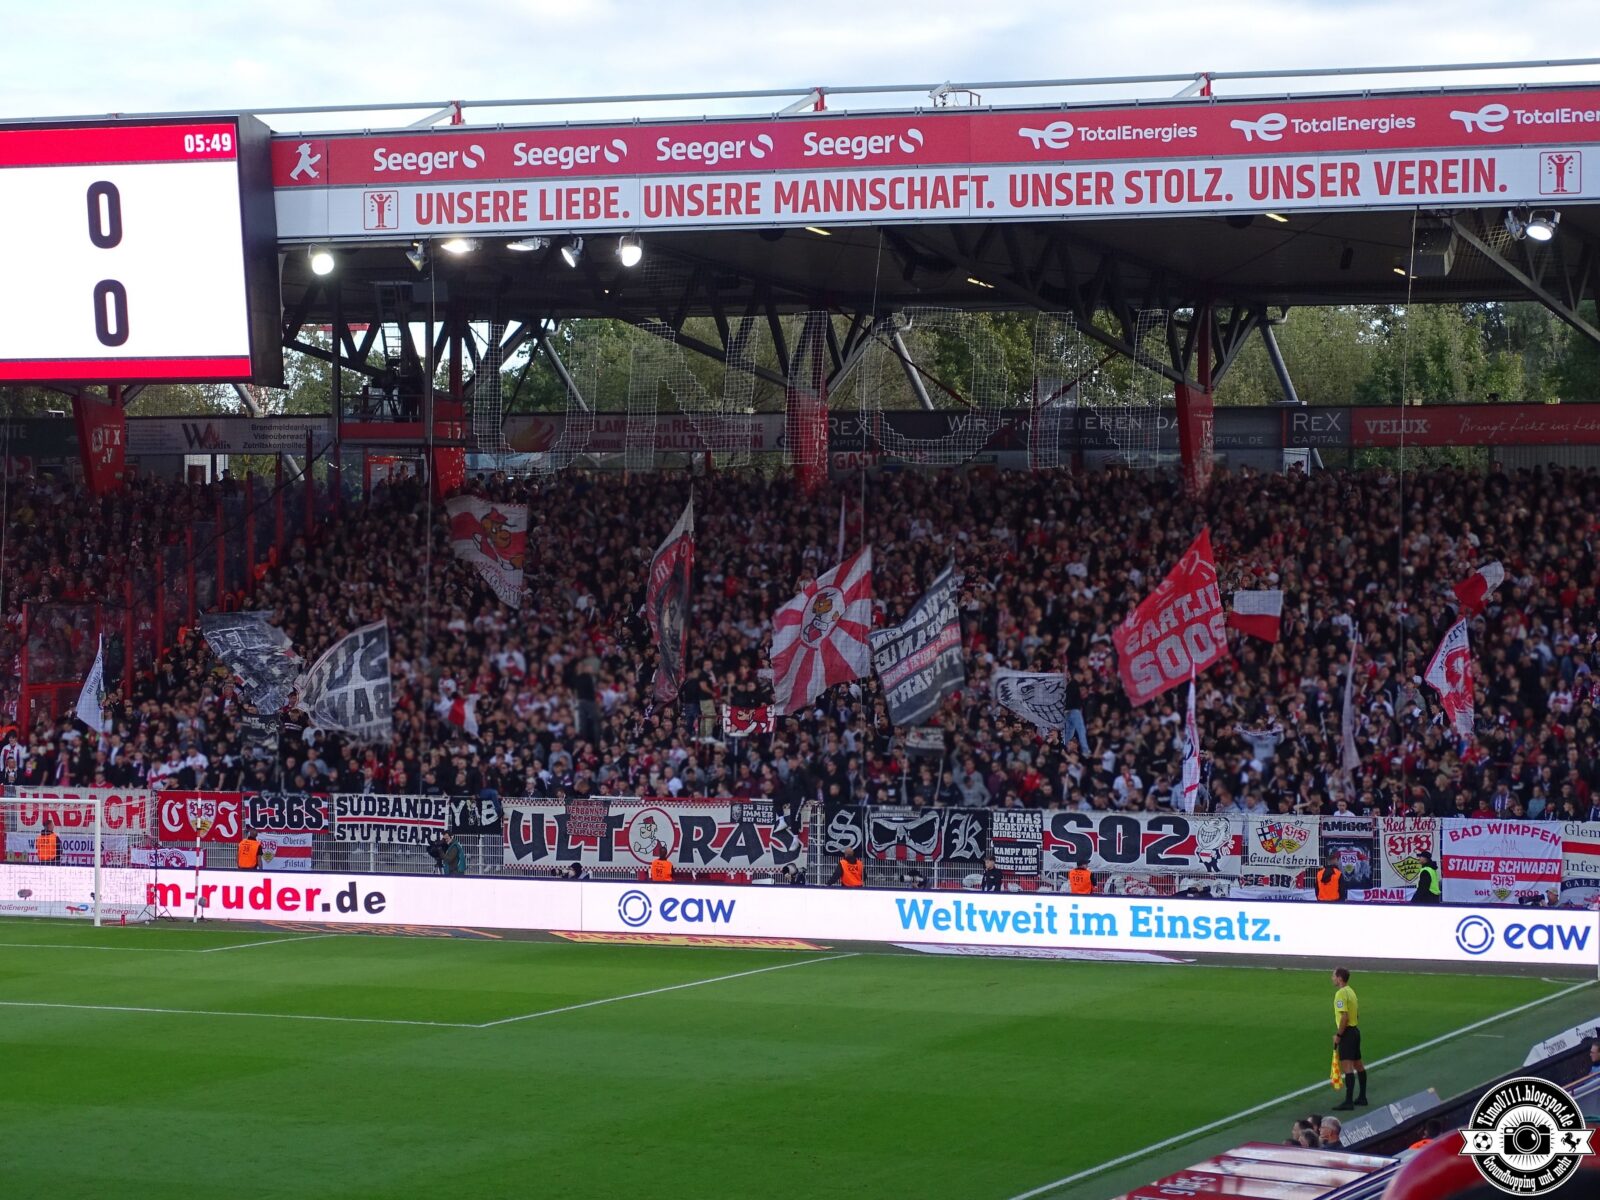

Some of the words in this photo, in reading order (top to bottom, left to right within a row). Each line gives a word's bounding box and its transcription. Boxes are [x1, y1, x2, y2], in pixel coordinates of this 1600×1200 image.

[1077, 123, 1198, 143] TotalEnergies
[1291, 114, 1416, 134] TotalEnergies
[183, 132, 232, 153] 05:49
[656, 137, 745, 165] Seeger
[803, 131, 894, 160] Seeger
[373, 148, 458, 175] Seeger
[513, 142, 600, 169] Seeger
[415, 189, 528, 225] UNSERE
[539, 186, 630, 222] LIEBE.
[644, 181, 761, 218] UNSERE
[774, 175, 995, 214] MANNSCHAFT.
[1009, 171, 1114, 208] UNSER
[1124, 168, 1234, 205] STOLZ.
[1249, 162, 1360, 201] UNSER
[1374, 158, 1508, 196] VEREIN.
[87, 181, 123, 249] 0
[93, 279, 129, 347] 0
[1001, 415, 1142, 431] FINZIEREN
[1293, 412, 1342, 432] REX
[1364, 418, 1428, 434] VELUX
[243, 441, 325, 450] Zutrittskontrolltecik
[1293, 435, 1342, 444] CAPITAL
[20, 792, 147, 830] URBACH
[249, 796, 324, 830] C36S
[336, 794, 446, 819] SÜDBANDE
[992, 822, 1041, 832] BEDEUTET
[993, 812, 1041, 825] ULTRAS
[336, 823, 444, 845] STUTTGART
[992, 830, 1043, 840] WIDERSTAND
[1449, 825, 1482, 842] BAD
[1487, 823, 1561, 846] WIMPFEN
[994, 847, 1020, 856] KAMPF
[1021, 848, 1038, 856] UND
[1250, 853, 1318, 866] Gundelsheim
[1448, 858, 1495, 873] STAUFER
[1498, 859, 1560, 875] SCHWABEN
[146, 877, 387, 914] m-ruder.de
[91, 907, 138, 916] TalEnergies
[659, 897, 736, 923] eaw
[895, 897, 1058, 935] Weltweit
[1069, 903, 1119, 937] im
[1129, 904, 1281, 942] Einsatz.
[1503, 923, 1591, 951] eaw
